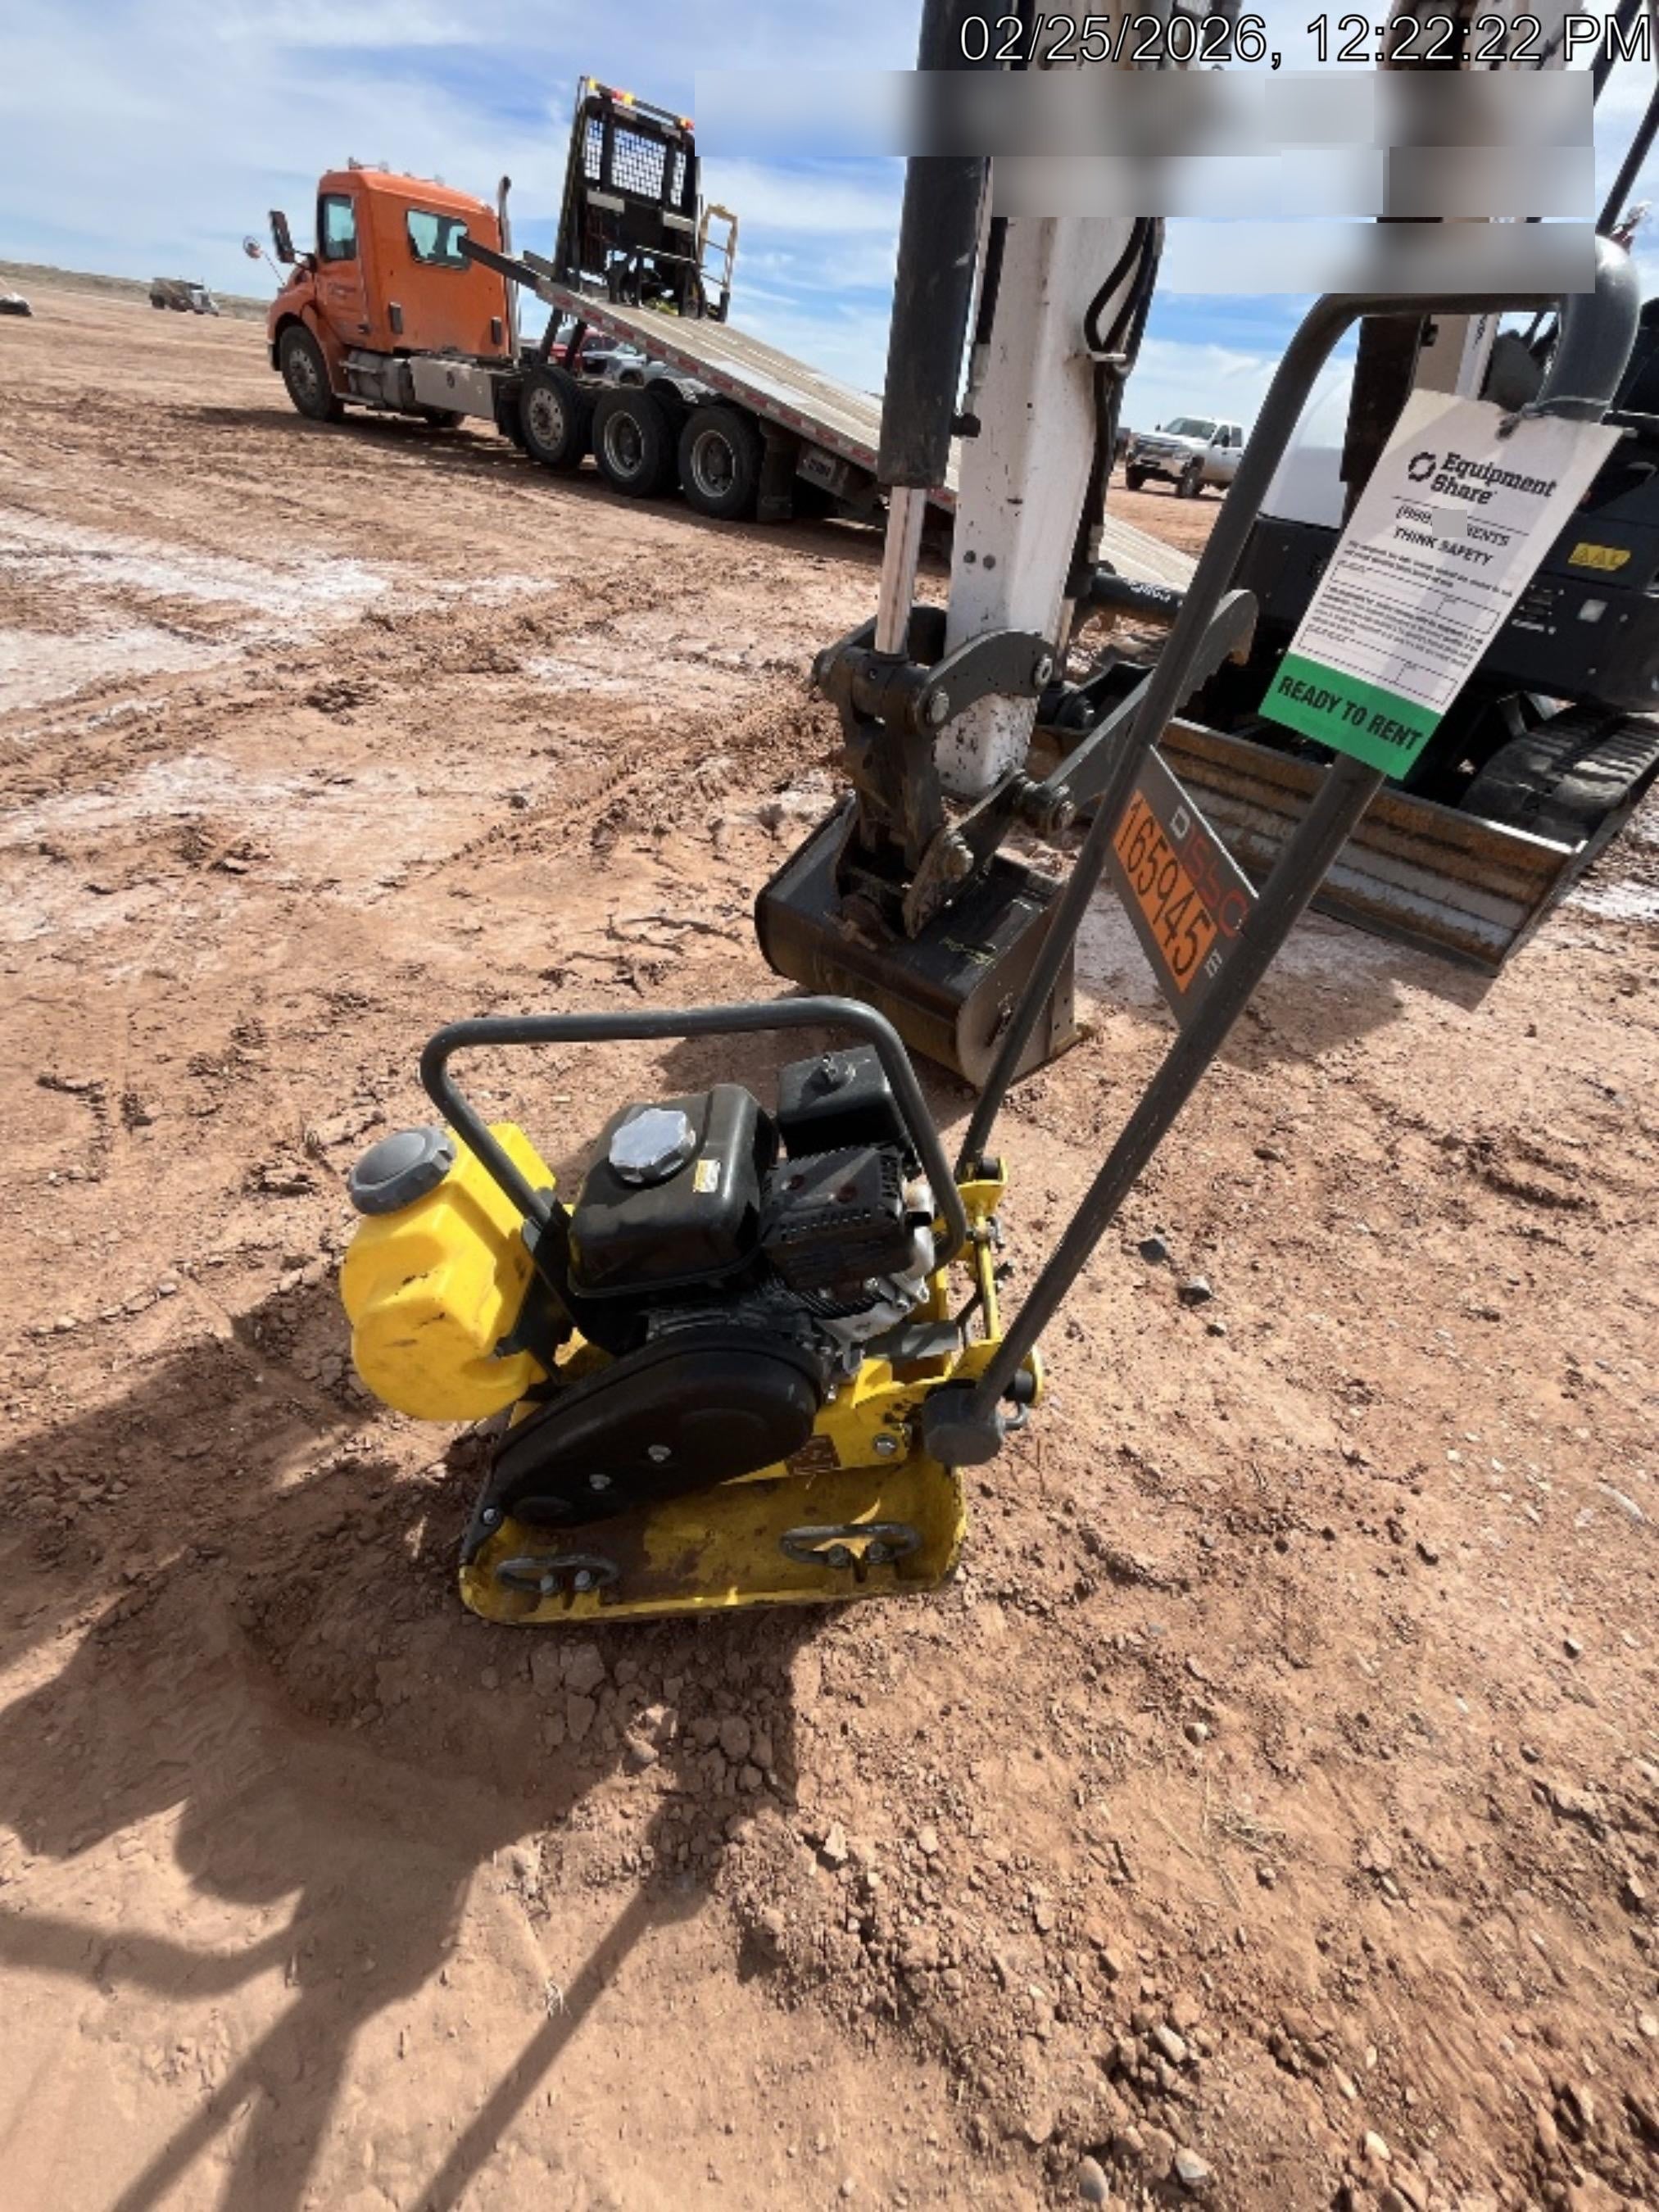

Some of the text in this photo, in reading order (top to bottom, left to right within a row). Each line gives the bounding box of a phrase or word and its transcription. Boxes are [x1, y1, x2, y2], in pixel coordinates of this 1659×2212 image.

[1430, 474, 1493, 505] Share
[1441, 451, 1557, 497] Equipment
[1394, 526, 1494, 566] THINK SAFETY
[1278, 675, 1423, 750] READY TO RENT
[1117, 798, 1212, 977] 165945
